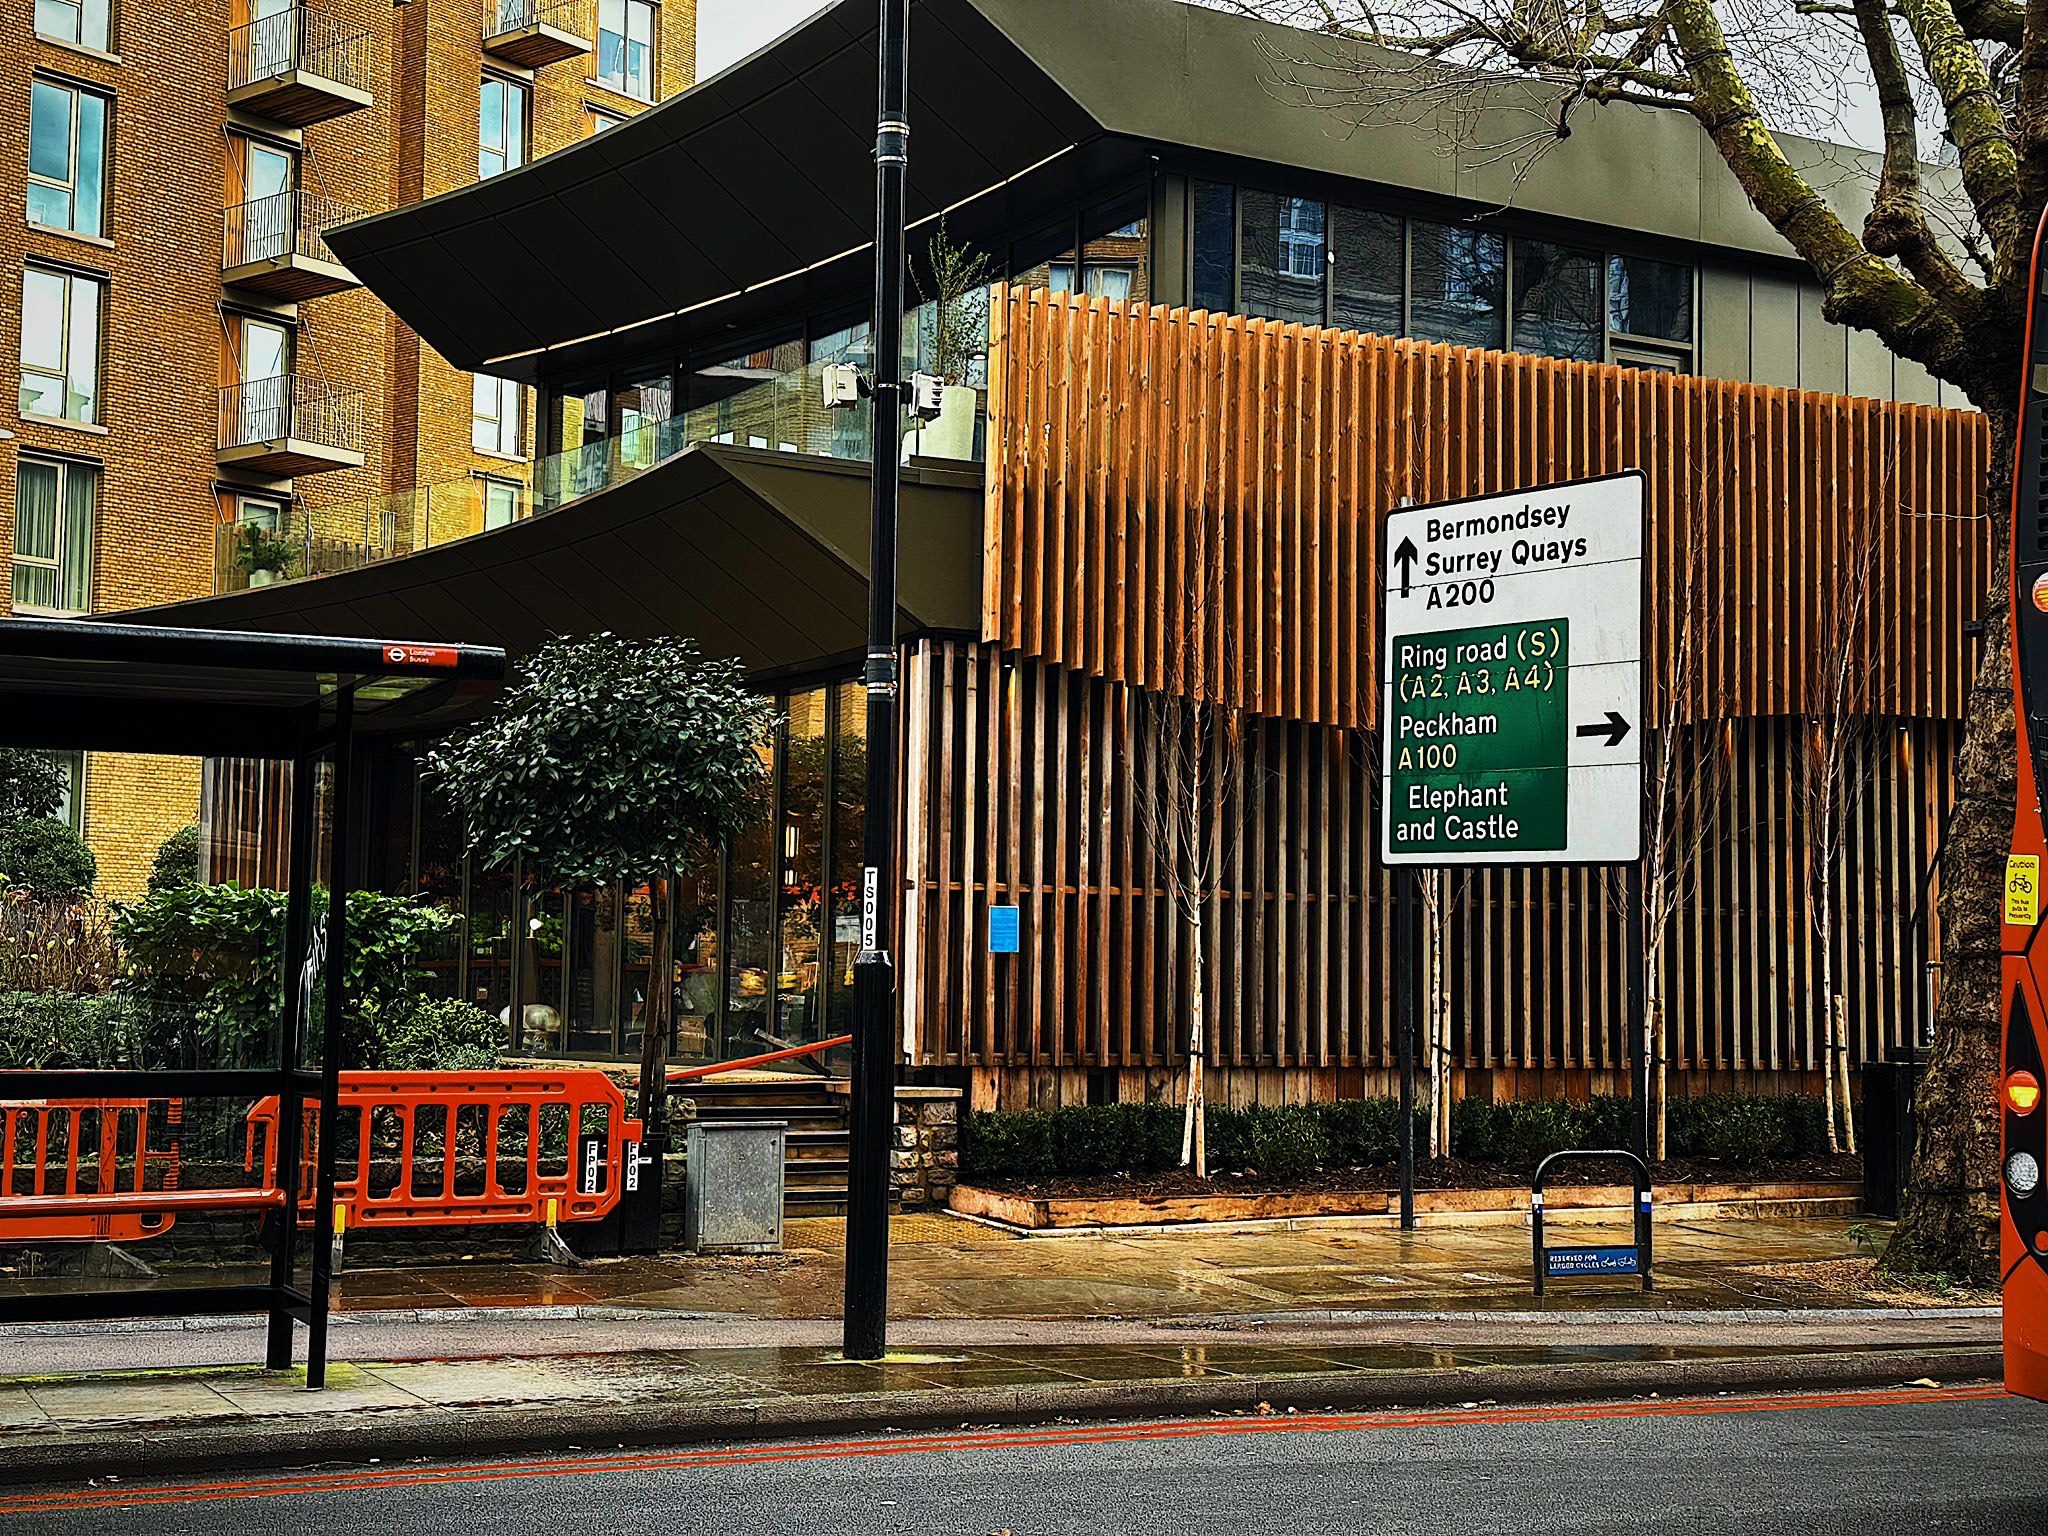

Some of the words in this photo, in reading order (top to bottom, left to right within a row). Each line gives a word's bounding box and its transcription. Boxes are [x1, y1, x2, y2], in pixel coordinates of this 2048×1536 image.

[1426, 504, 1570, 542] Bermondsey
[1425, 549, 1502, 576] Surrey
[1511, 537, 1587, 566] Quays
[1426, 578, 1495, 610] A200
[1401, 644, 1447, 670] Ring
[1456, 634, 1507, 664] road
[1517, 627, 1560, 661] (S)
[1400, 673, 1449, 703] (A2,
[1456, 669, 1496, 695] A3,
[1504, 660, 1554, 692] A4)
[1400, 711, 1497, 739] Peckham
[1398, 743, 1457, 770] A100
[1409, 781, 1508, 813] Elephant
[1396, 816, 1436, 841] and
[1445, 814, 1519, 840] Castle
[865, 871, 875, 947] TS005
[587, 1143, 596, 1191] FP02
[1575, 1261, 1600, 1269] CYCLES
